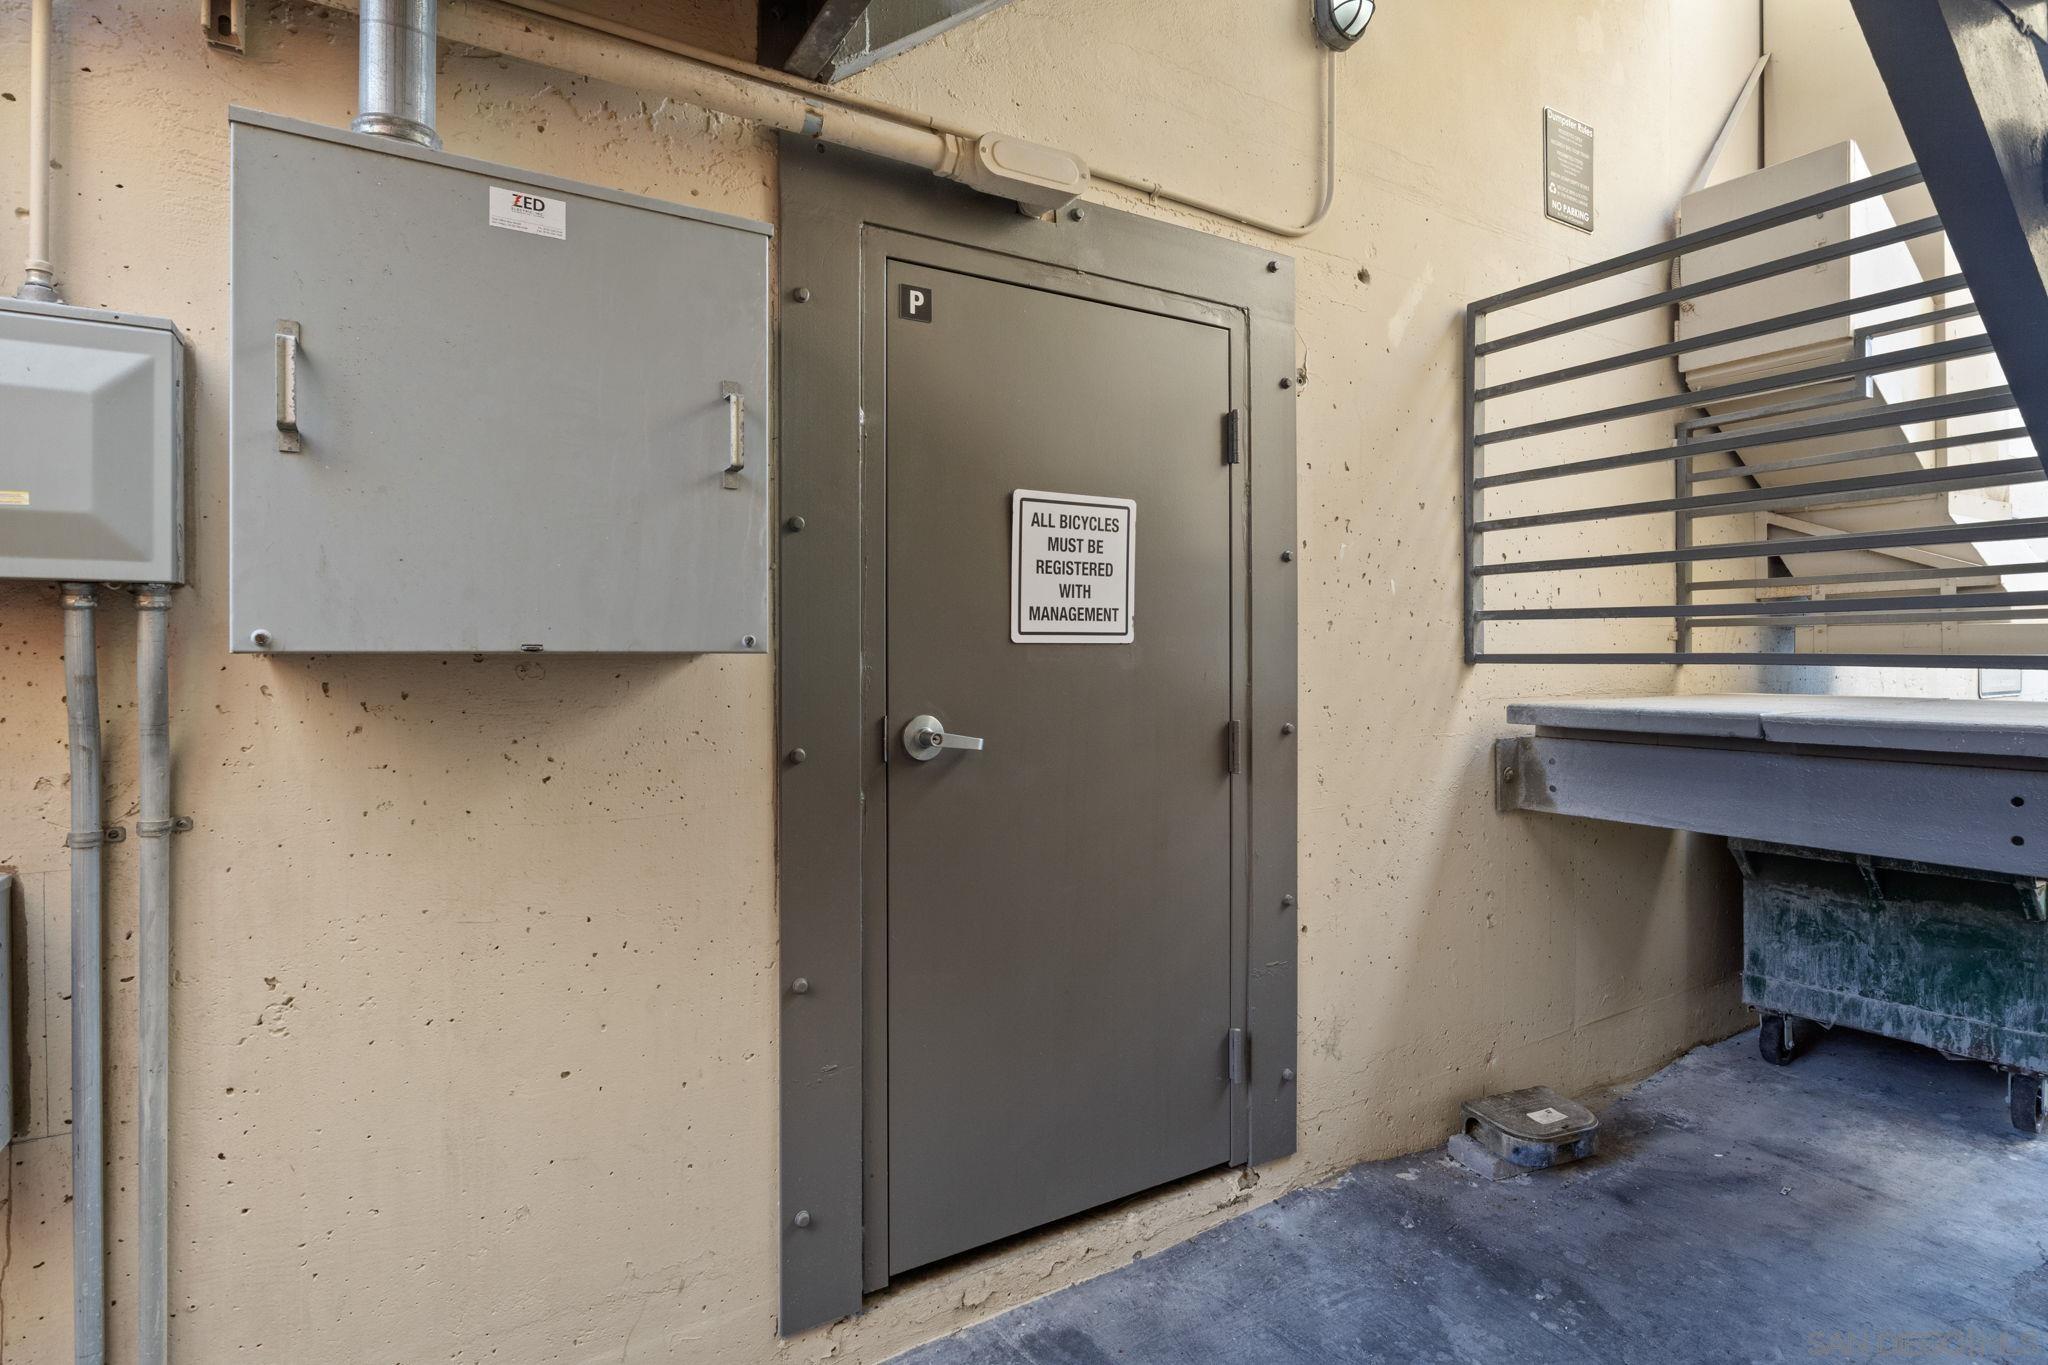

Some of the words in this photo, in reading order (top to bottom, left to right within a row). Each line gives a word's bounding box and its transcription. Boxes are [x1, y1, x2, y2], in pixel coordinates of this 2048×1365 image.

[1547, 109, 1577, 129] Dumpster
[1577, 123, 1593, 138] Rules
[512, 193, 545, 212] ZED
[1551, 199, 1562, 212] NO
[1563, 204, 1589, 222] PARKING
[910, 289, 925, 315] P
[1031, 512, 1056, 529] ALL
[1059, 514, 1120, 533] BICYCLES
[1048, 536, 1084, 553] MUST
[1087, 539, 1104, 555] BE
[1036, 559, 1114, 577] REGISTERED
[1059, 583, 1091, 599] WITH
[1029, 606, 1119, 622] MANAGEMENT
